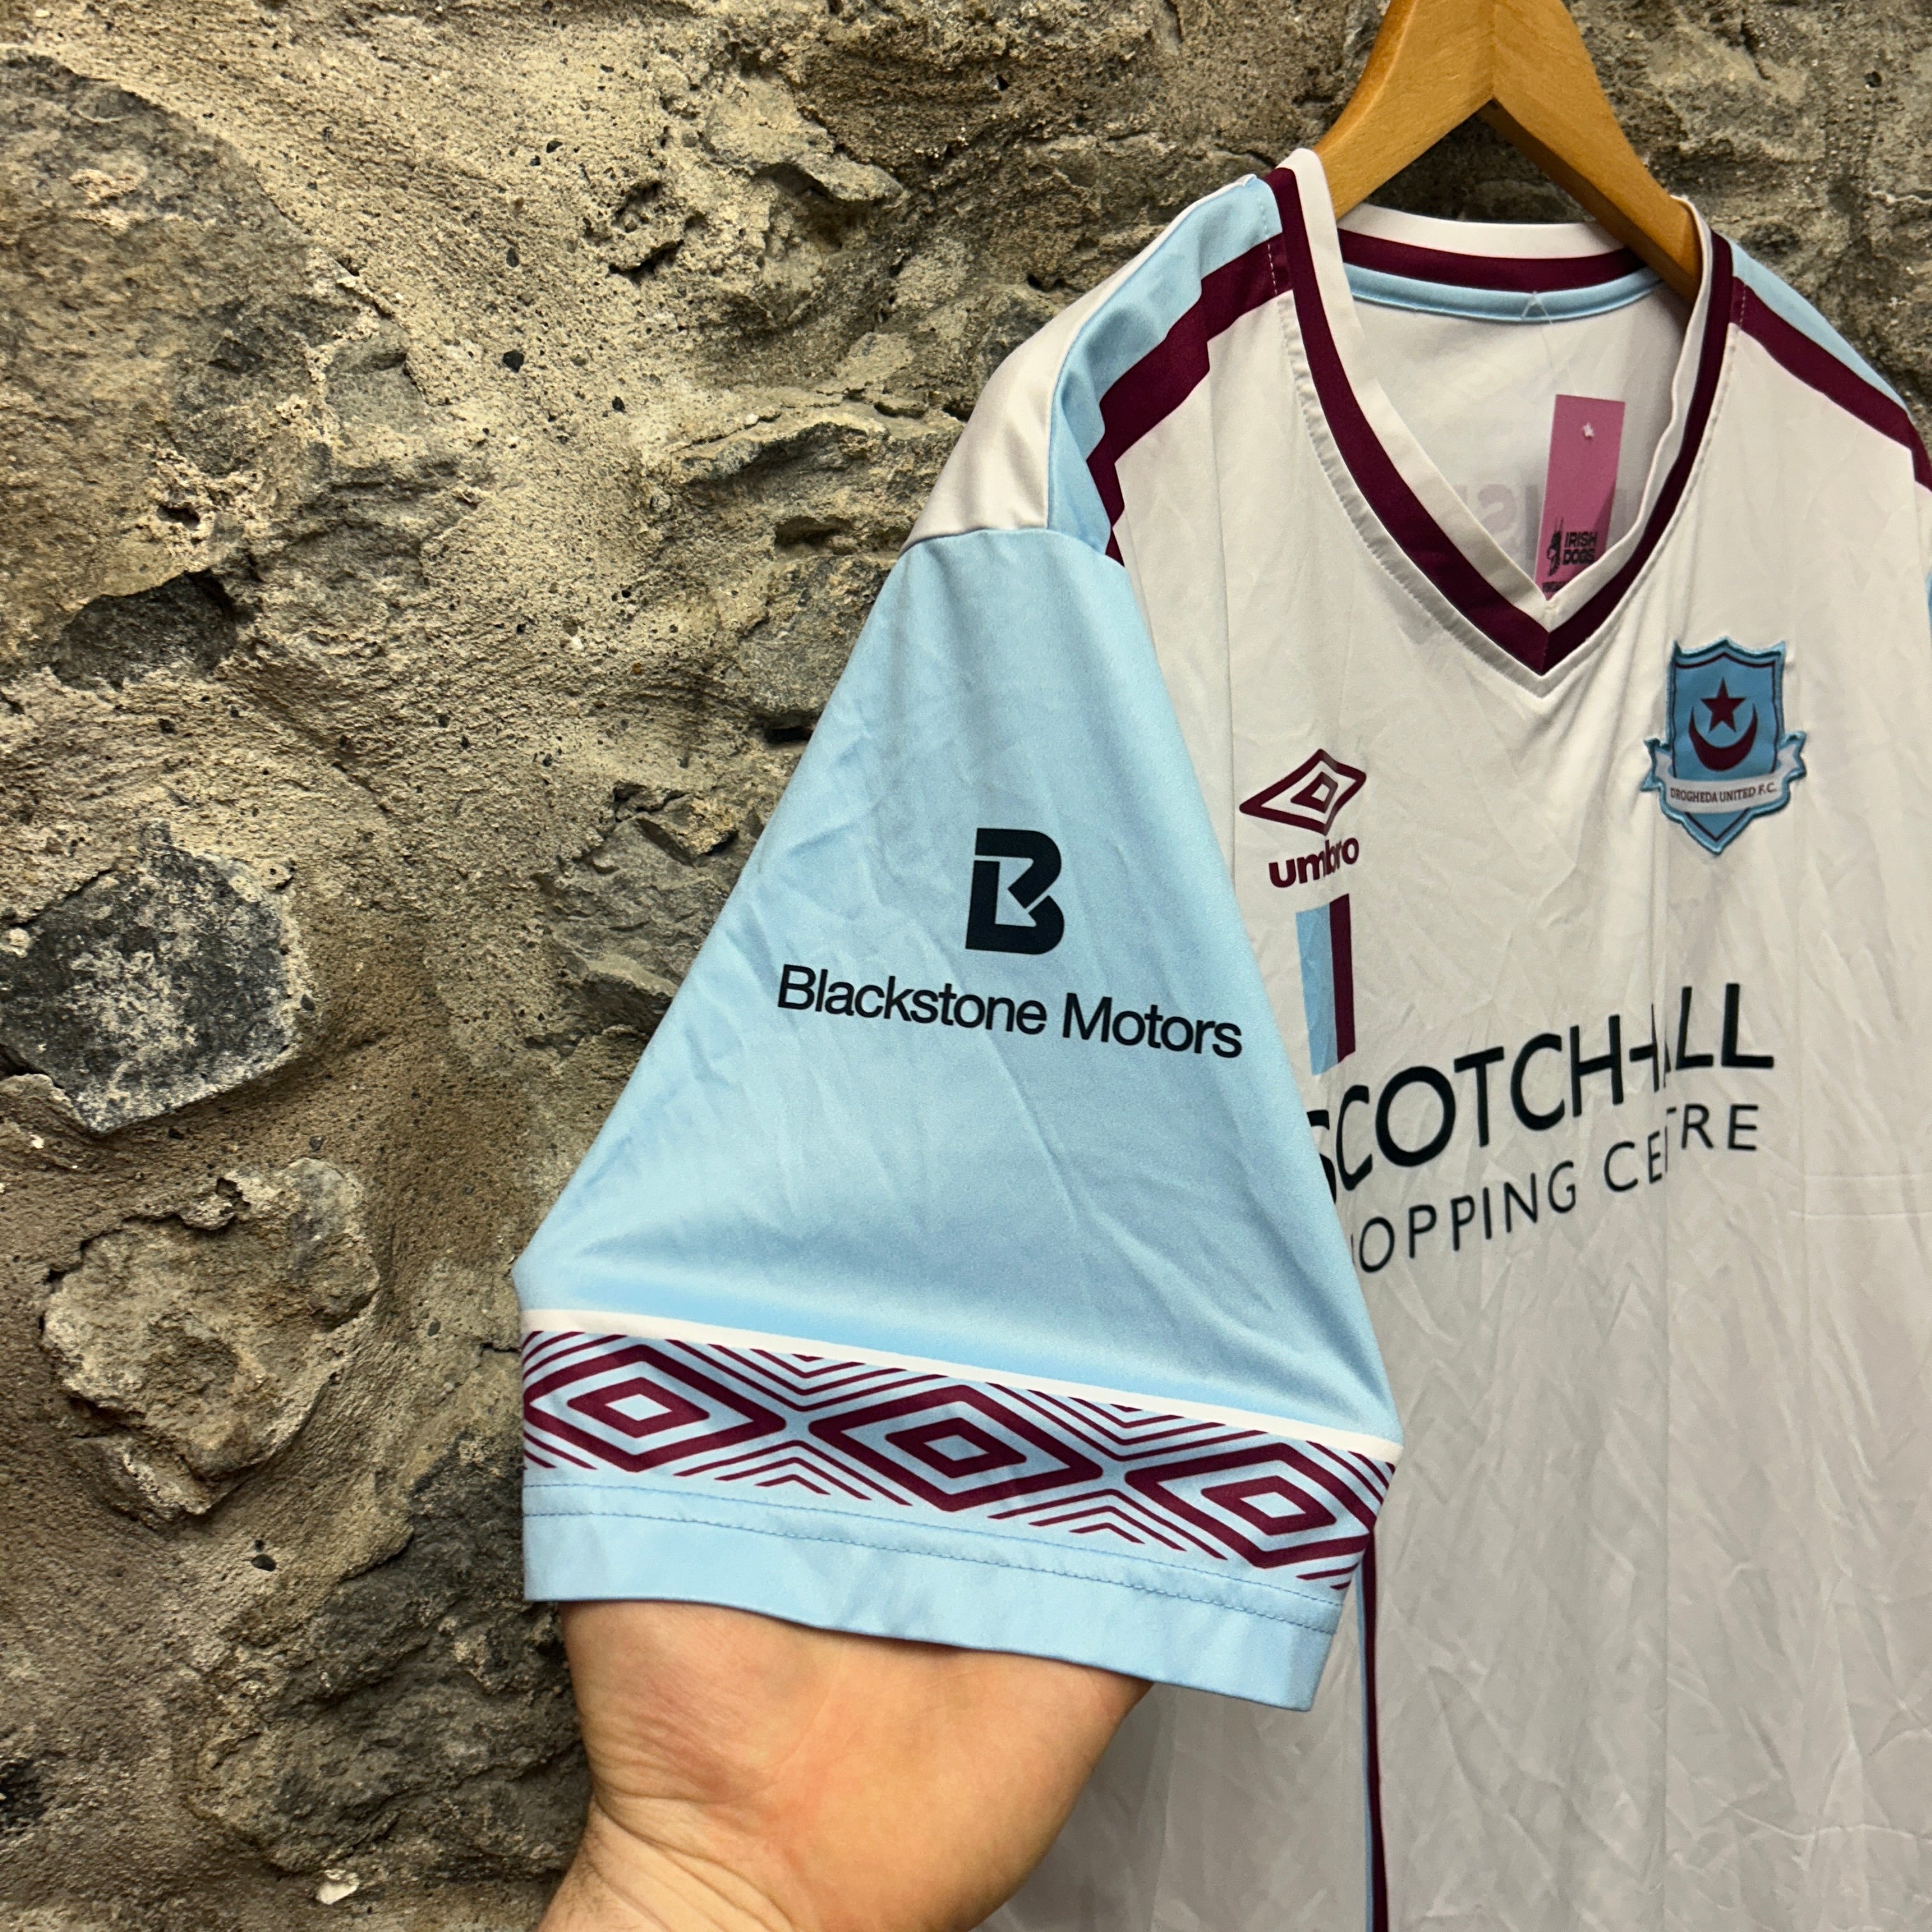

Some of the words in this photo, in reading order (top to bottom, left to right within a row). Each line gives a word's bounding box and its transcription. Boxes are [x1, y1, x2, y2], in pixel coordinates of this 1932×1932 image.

[1564, 531, 1598, 548] IRISH
[1562, 548, 1596, 565] DOGS
[1669, 787, 1719, 803] DROGHEDA
[1719, 786, 1756, 802] UNITED
[1268, 838, 1360, 888] umbro
[778, 963, 1047, 1035] Blackstone
[1062, 992, 1242, 1059] Motors
[1351, 1160, 1577, 1273] OPPING
[1604, 1103, 1759, 1192] CERE
